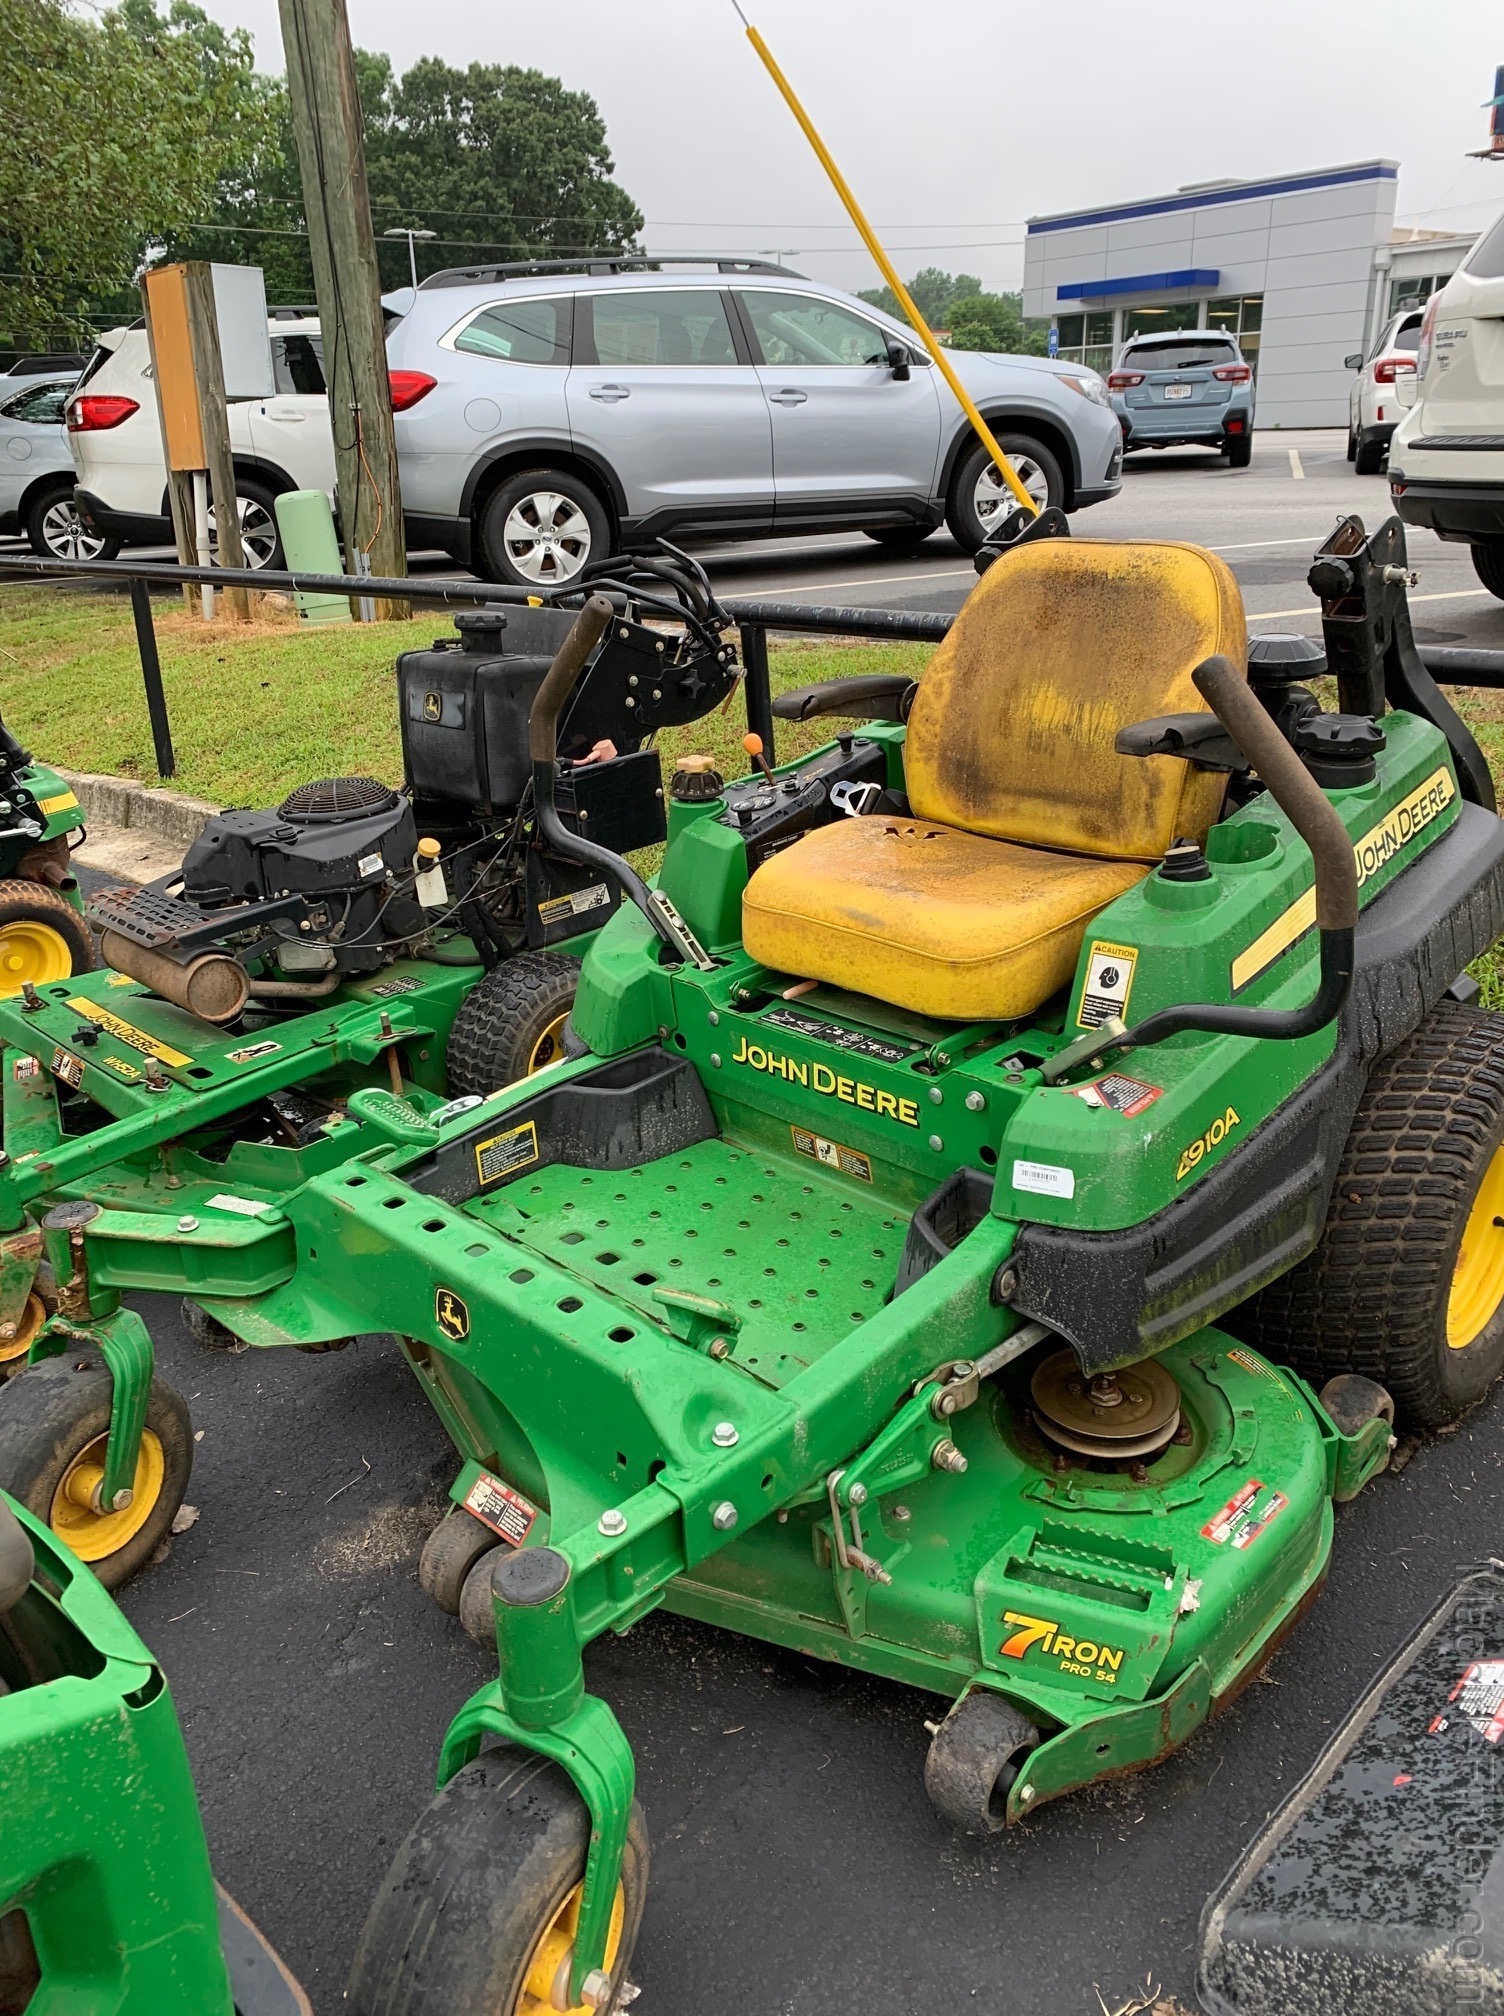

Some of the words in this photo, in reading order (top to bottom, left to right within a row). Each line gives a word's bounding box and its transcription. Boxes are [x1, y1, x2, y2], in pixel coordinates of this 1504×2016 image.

[1356, 824, 1398, 880] JOHN
[1397, 780, 1447, 840] DEERE
[1101, 946, 1136, 959] CAUTION
[87, 1013, 125, 1033] JOHN
[117, 1028, 160, 1052] DEERE
[102, 1055, 142, 1079] WH52A
[732, 1037, 809, 1088] JOHN
[813, 1062, 920, 1128] DEERE
[1041, 1631, 1125, 1671] IRON
[1059, 1660, 1092, 1677] PRO
[1095, 1669, 1116, 1684] 54
